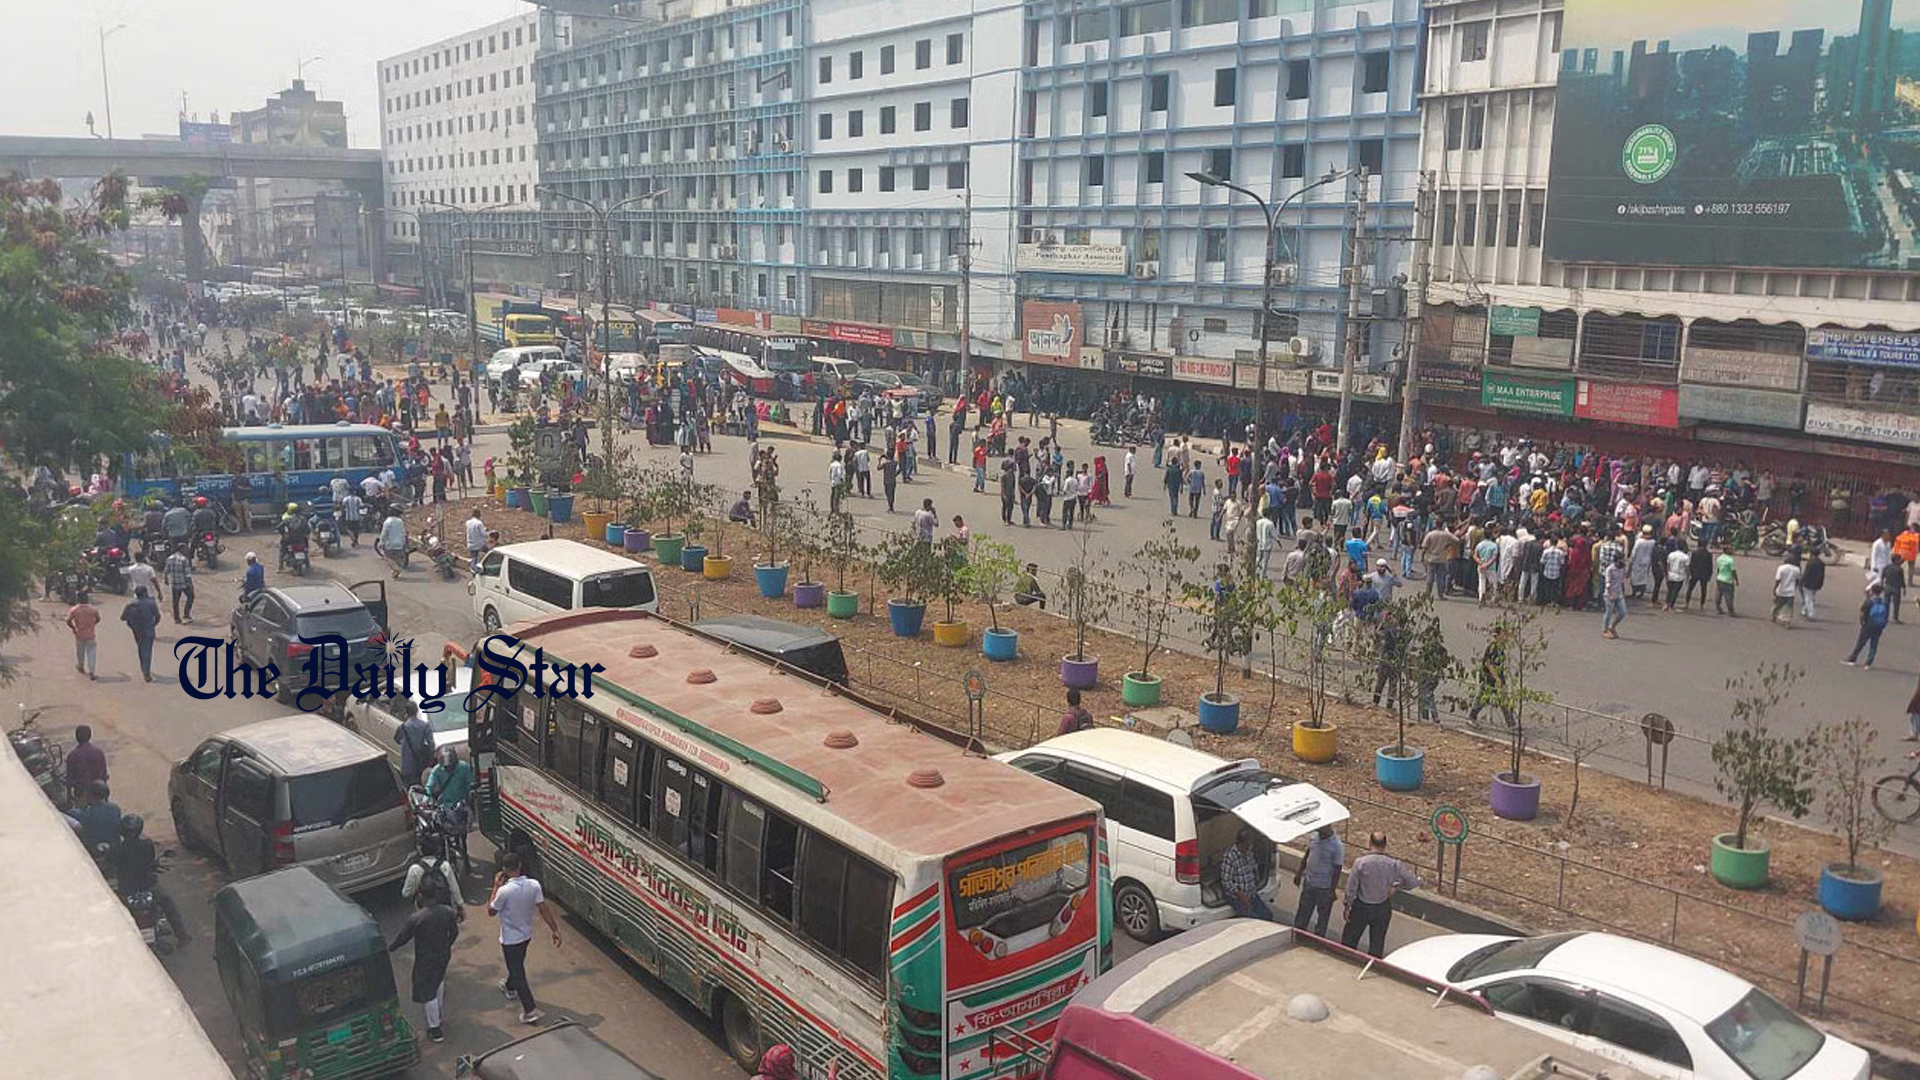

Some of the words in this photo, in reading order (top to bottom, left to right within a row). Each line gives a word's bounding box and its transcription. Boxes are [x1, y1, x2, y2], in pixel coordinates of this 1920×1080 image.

[1731, 203, 1753, 214] 1332
[1755, 203, 1790, 214] 556197
[1515, 387, 1563, 401] ENTERPRISE
[959, 868, 1016, 899] গাজীপুর
